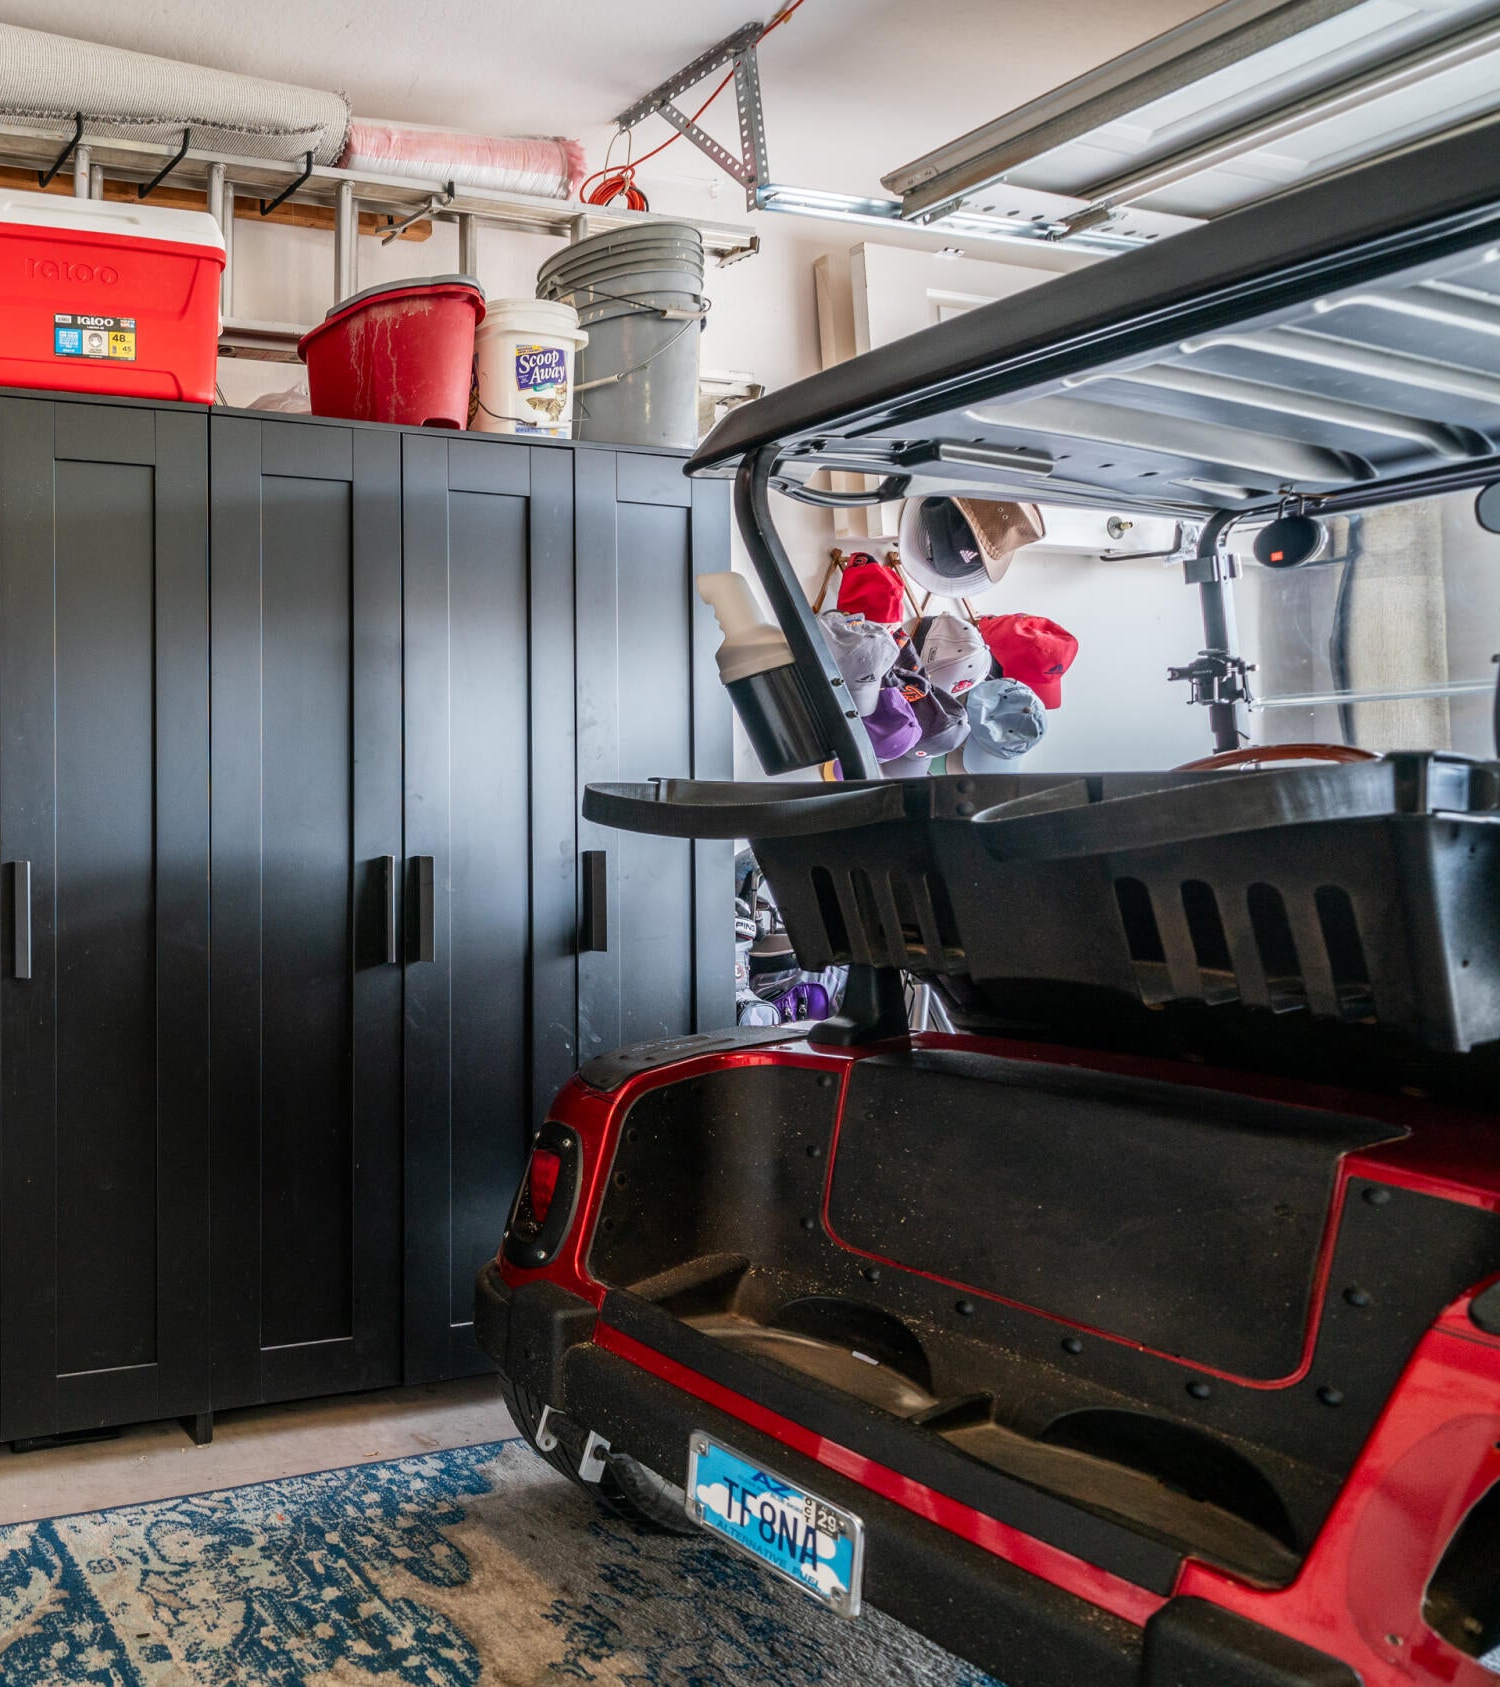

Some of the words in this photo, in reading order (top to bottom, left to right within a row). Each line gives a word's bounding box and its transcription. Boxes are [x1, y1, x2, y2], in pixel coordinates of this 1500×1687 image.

[25, 258, 119, 285] IGLOO
[77, 316, 114, 327] IGLOO
[112, 334, 126, 343] 48
[518, 350, 559, 374] Scoop
[528, 365, 565, 385] Away
[735, 921, 756, 932] PING
[752, 1472, 791, 1501] AZ
[804, 1497, 813, 1524] OCT
[817, 1510, 837, 1532] 29
[723, 1476, 818, 1572] TF8NA
[716, 1520, 788, 1570] ALTERNATIVE
[792, 1566, 819, 1588] FUEL
